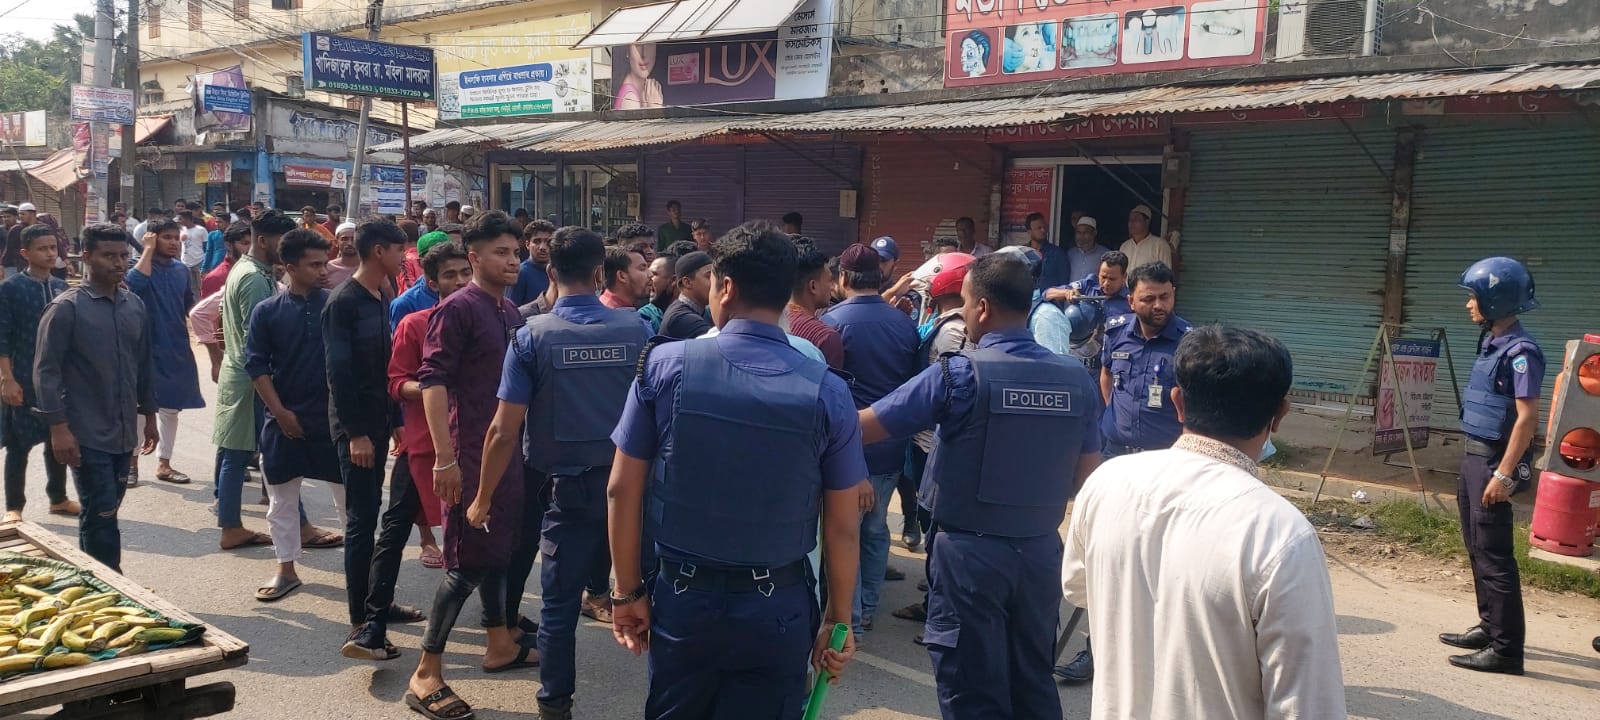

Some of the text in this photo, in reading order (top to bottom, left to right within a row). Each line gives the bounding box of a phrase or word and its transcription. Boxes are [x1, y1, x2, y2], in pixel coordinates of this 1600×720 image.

[315, 52, 351, 80] খাদিজাতুল
[352, 60, 371, 81] কুবরা
[385, 60, 404, 81] মহিলা
[406, 67, 430, 85] মাদরাসা
[703, 40, 777, 87] LUX
[569, 348, 620, 361] POLICE
[1009, 392, 1064, 407] POLICE
